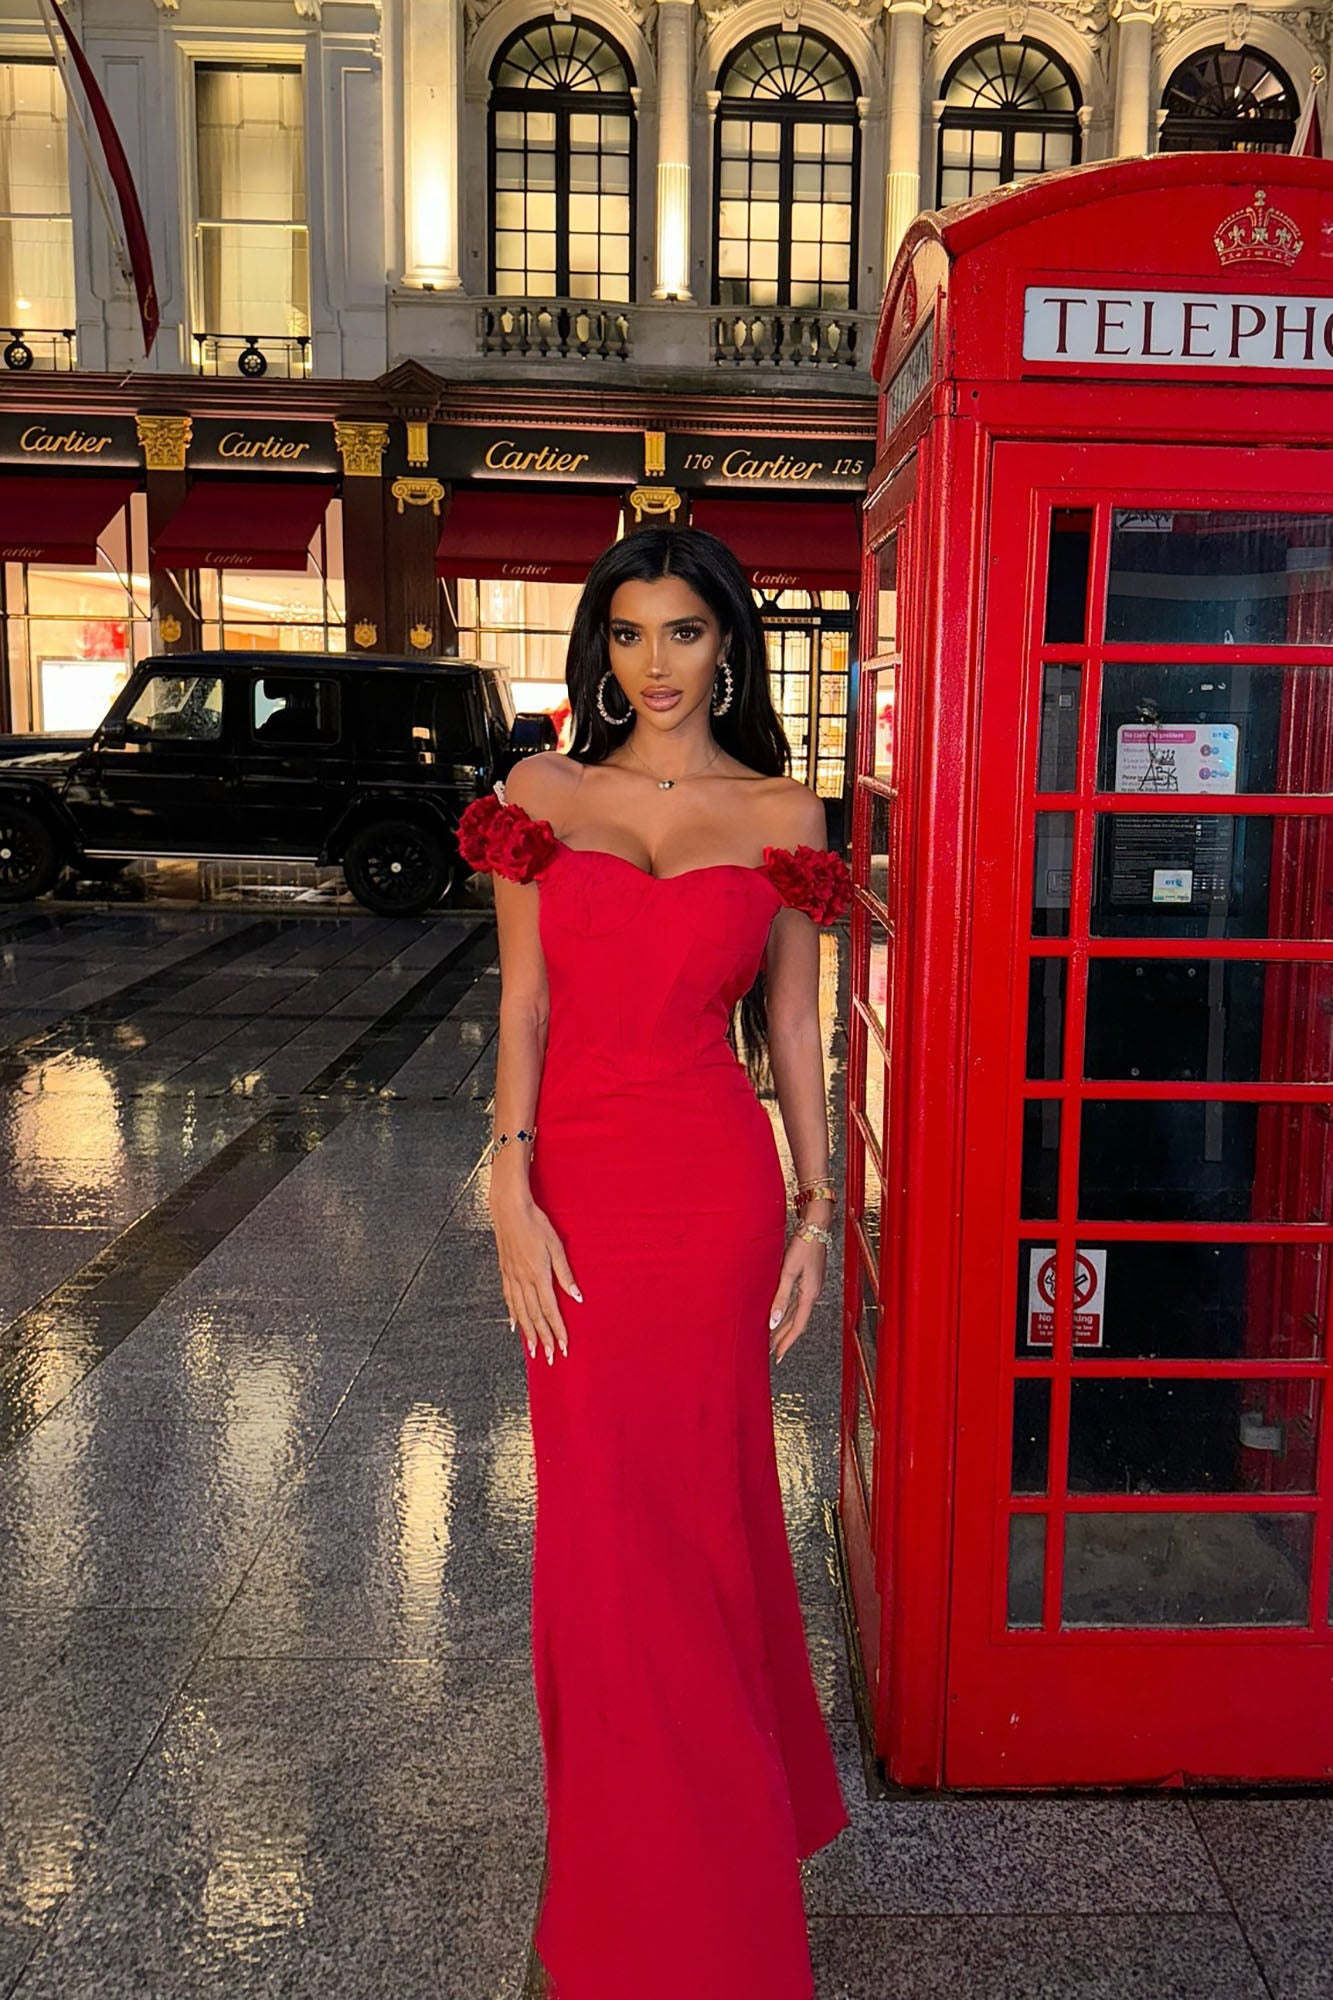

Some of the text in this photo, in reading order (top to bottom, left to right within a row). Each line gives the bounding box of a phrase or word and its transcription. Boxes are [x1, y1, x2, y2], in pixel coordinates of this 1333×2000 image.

[1043, 298, 1333, 360] TELEPH
[20, 426, 112, 453] Cartier
[218, 432, 310, 458] Cartier
[485, 440, 589, 471] Cartier
[683, 449, 864, 480] 176 Cartier 175
[205, 551, 253, 564] Cartier
[502, 563, 551, 575] Cartier
[752, 571, 800, 584] Cartier
[1039, 1313, 1052, 1322] No
